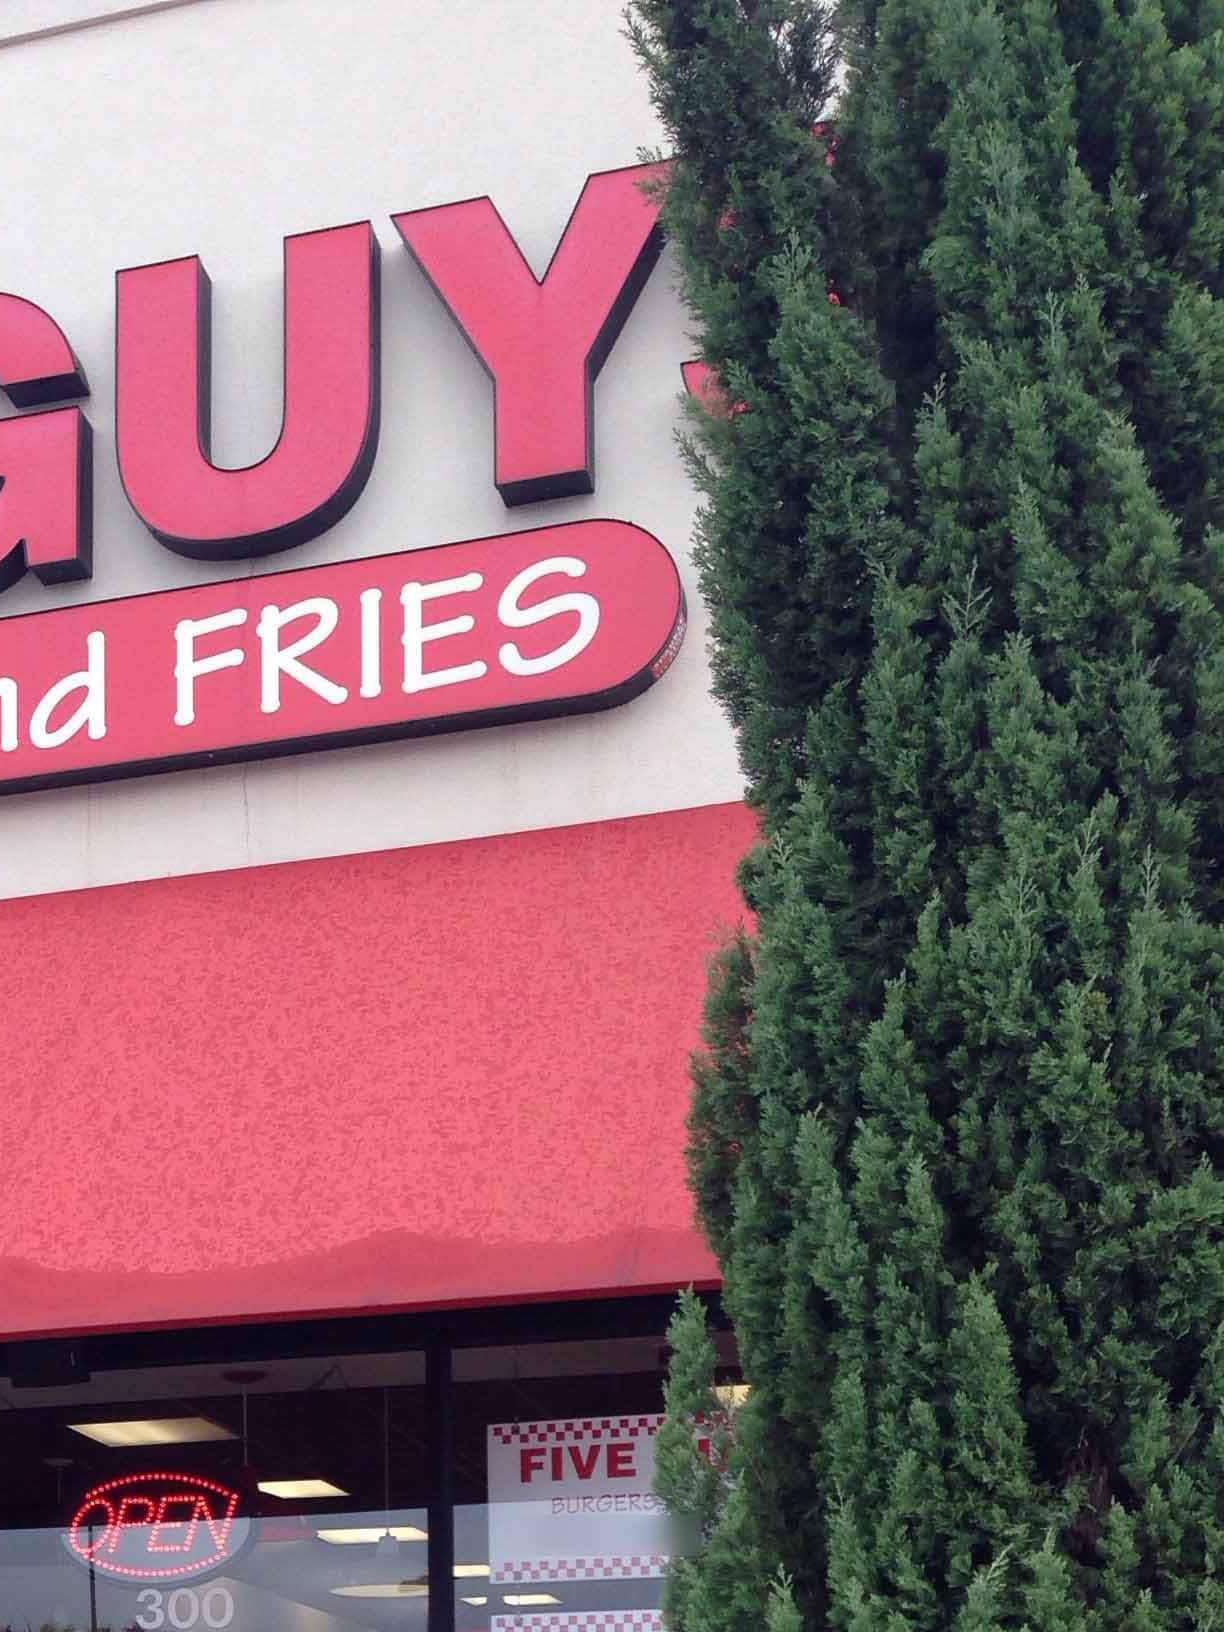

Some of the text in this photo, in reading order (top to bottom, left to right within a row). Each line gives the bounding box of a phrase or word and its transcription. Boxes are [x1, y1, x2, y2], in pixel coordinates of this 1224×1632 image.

[173, 554, 601, 727] FRIES
[520, 1442, 638, 1484] FIVE
[69, 1493, 241, 1556] OPEN
[551, 1492, 657, 1515] BURGERS
[135, 1587, 235, 1630] 300
